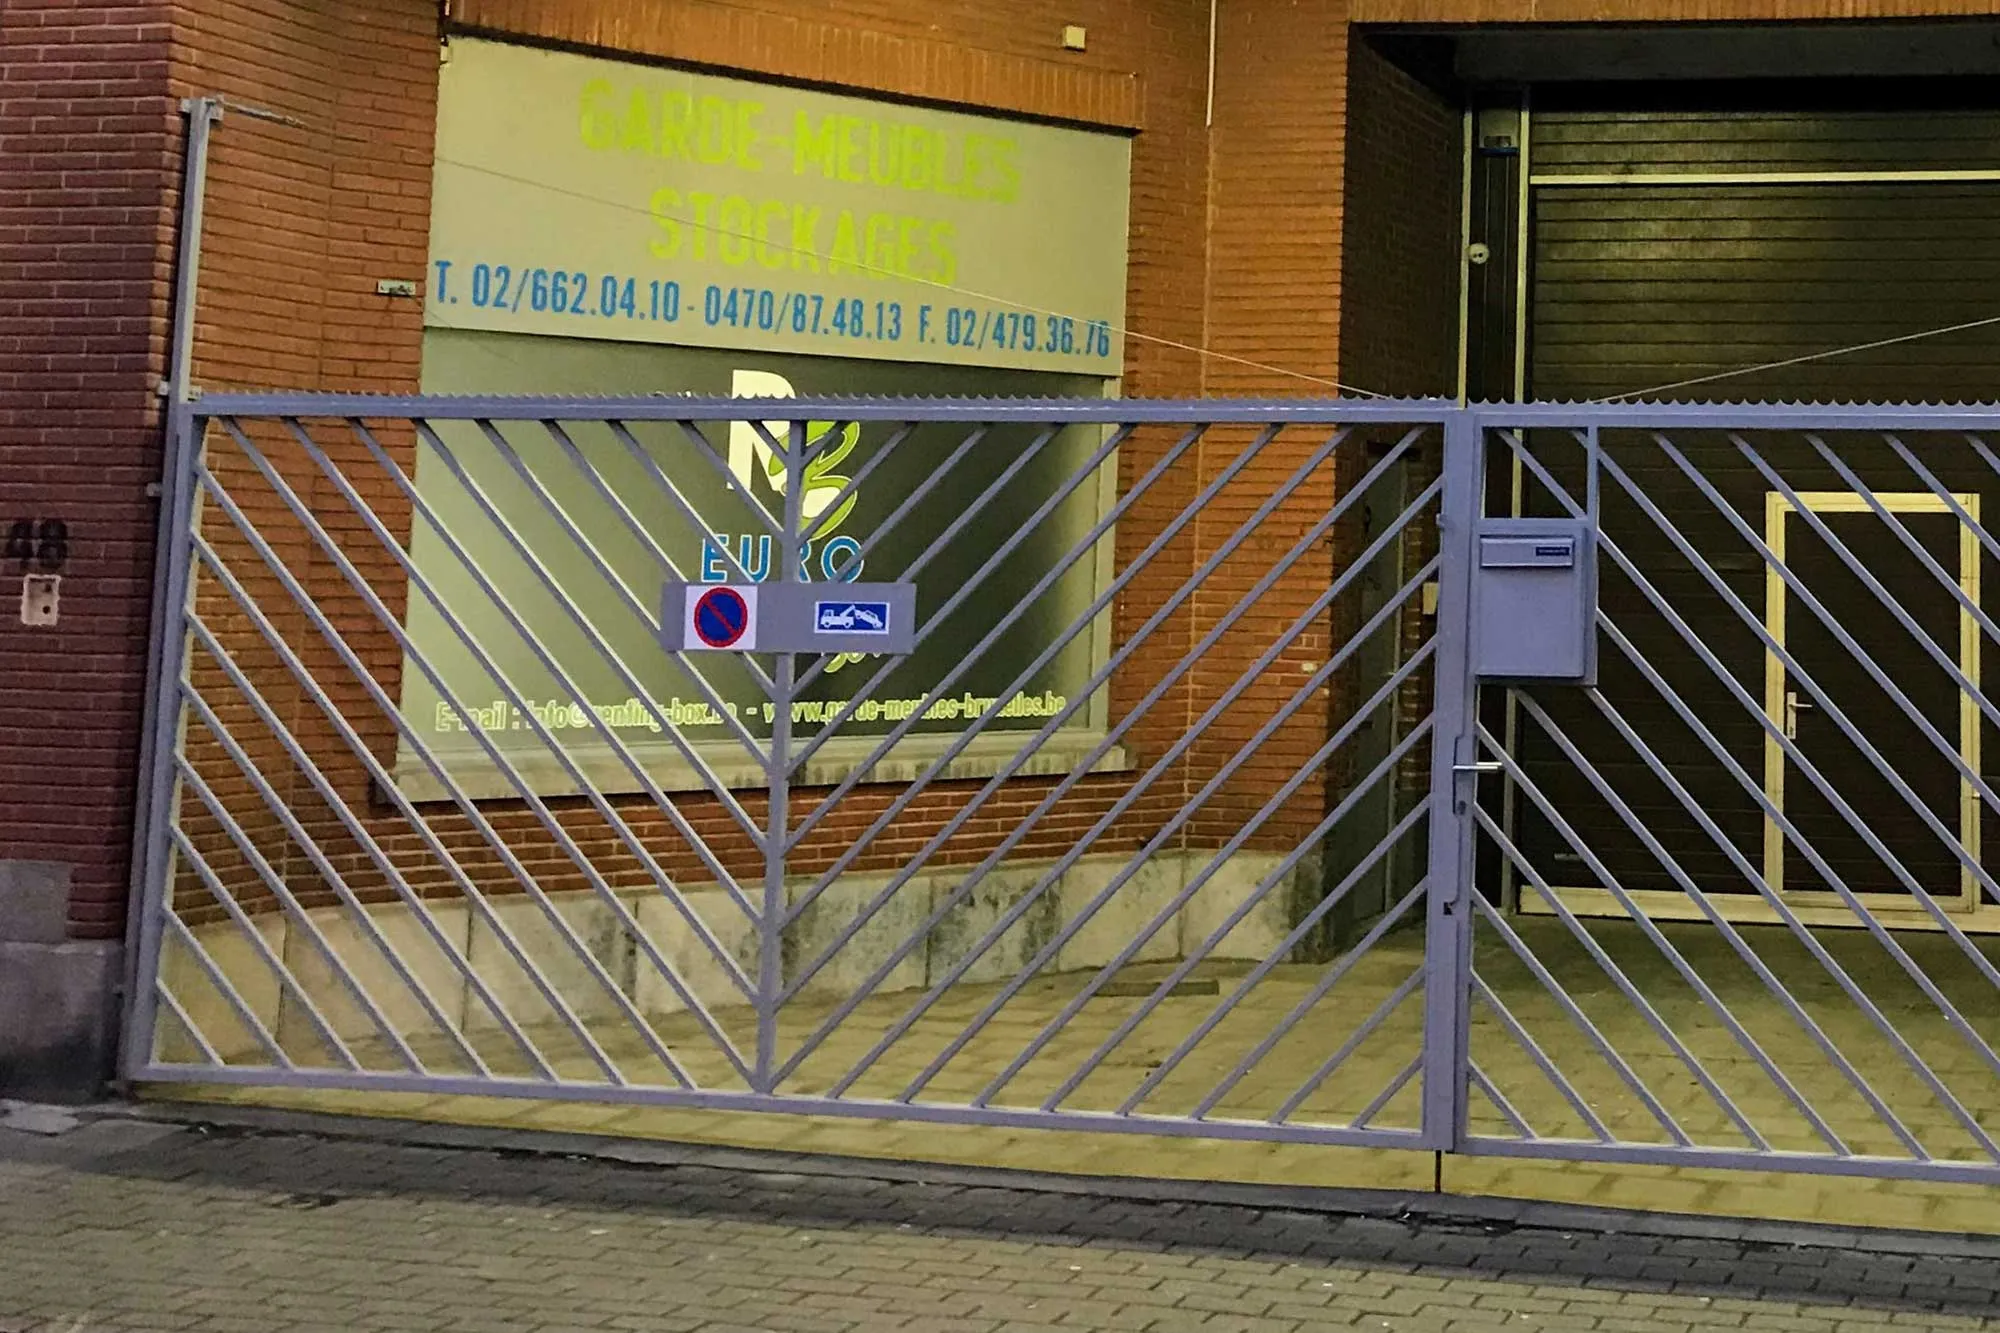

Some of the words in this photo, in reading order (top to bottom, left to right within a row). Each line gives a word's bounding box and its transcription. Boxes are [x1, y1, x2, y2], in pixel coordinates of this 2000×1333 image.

[578, 77, 1022, 205] GARDE-MEUBLES
[648, 187, 958, 286] STOCKAGES
[434, 260, 458, 305] T.
[471, 263, 681, 323] 02/662.04.10
[704, 284, 902, 341] 0470/87.48.13
[918, 304, 936, 345] F.
[946, 307, 1110, 358] 02/479.36.76
[5, 518, 68, 569] 48
